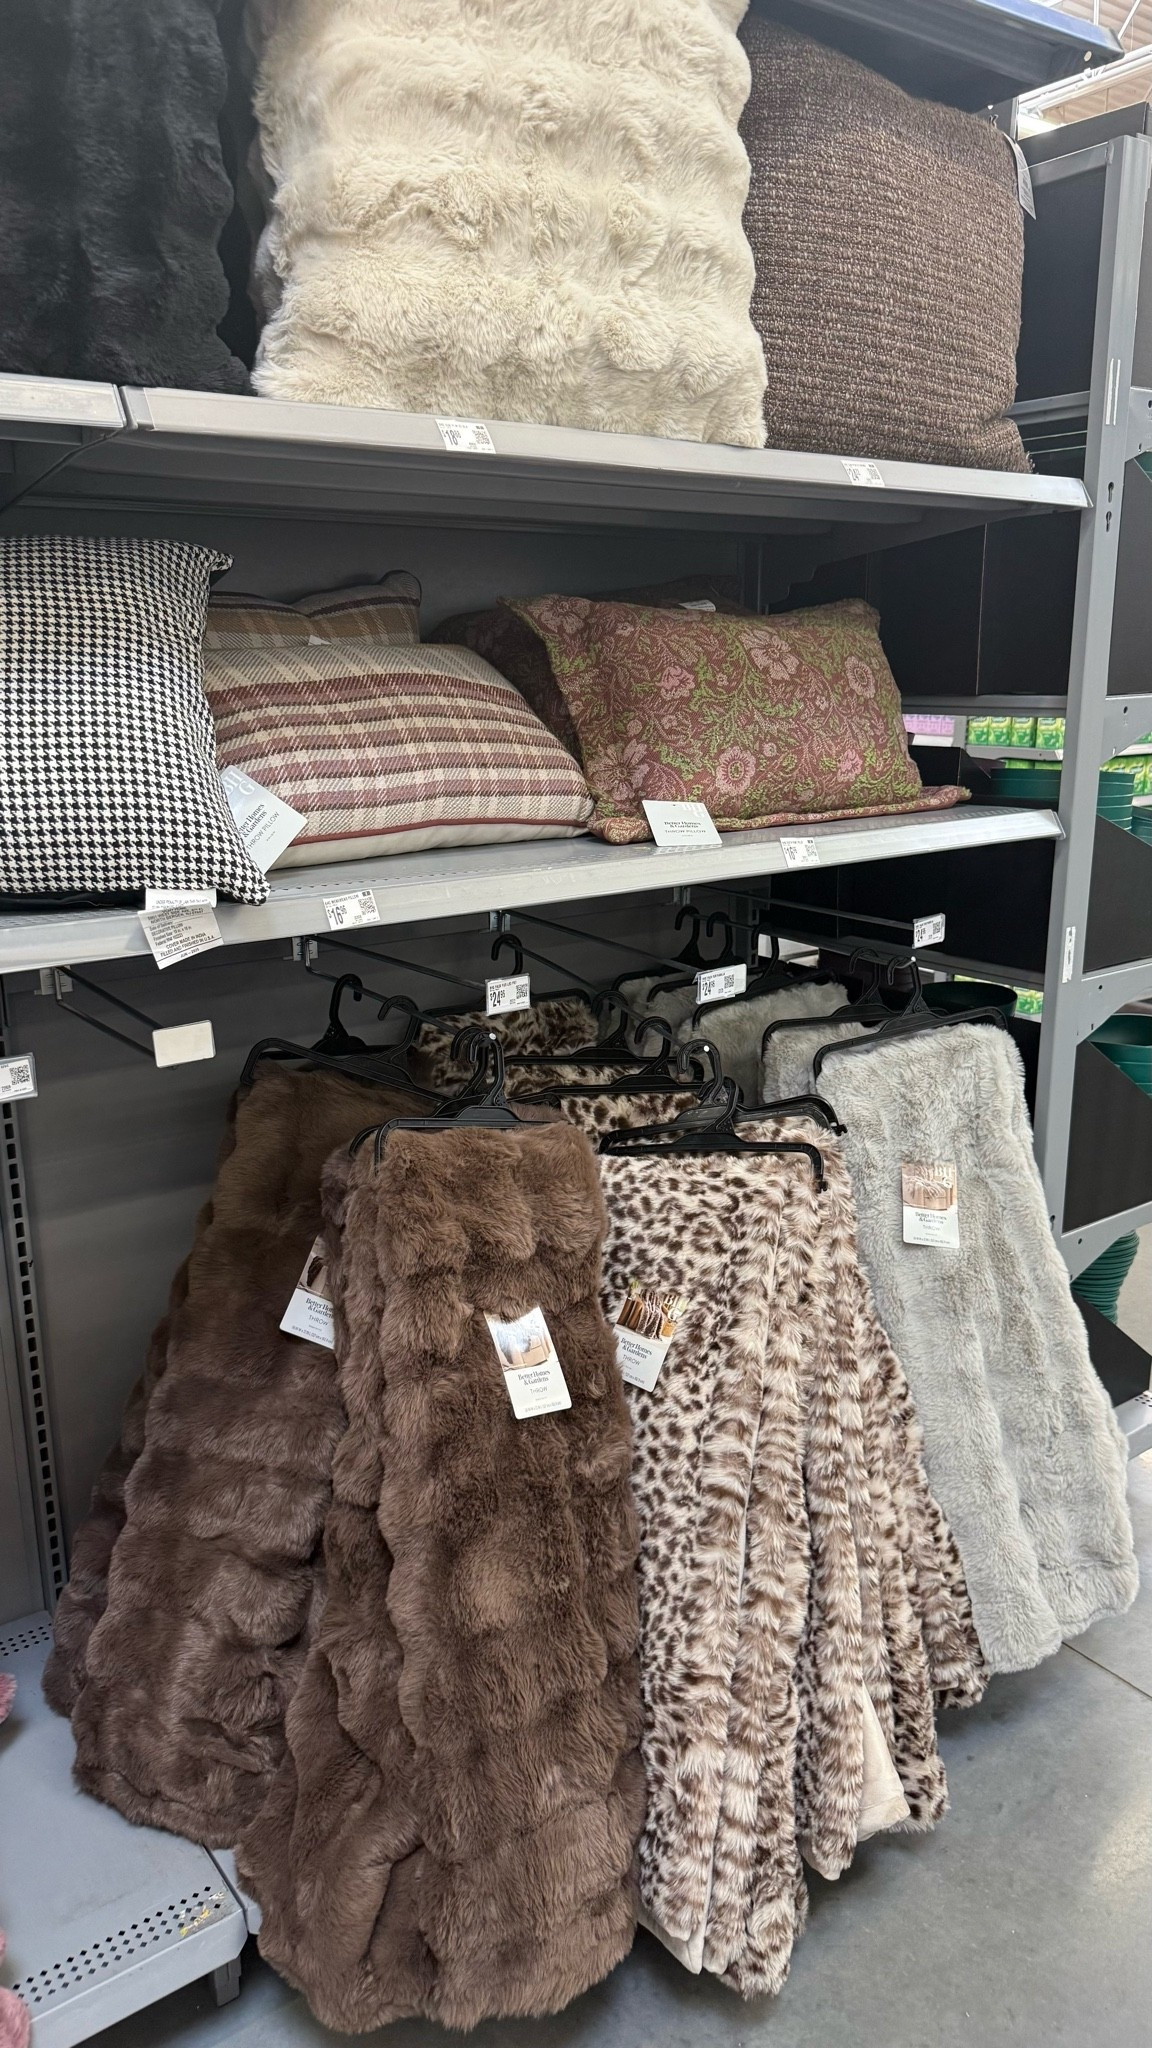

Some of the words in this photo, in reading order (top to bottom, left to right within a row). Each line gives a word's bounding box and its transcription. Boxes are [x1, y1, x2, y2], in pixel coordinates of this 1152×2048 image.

[248, 804, 265, 823] Homes
[247, 811, 268, 834] Gardens
[246, 830, 264, 850] THROW
[262, 811, 280, 831] PILLOW
[305, 1297, 323, 1309] Better
[312, 1306, 334, 1319] Garden
[308, 1314, 329, 1326] THROW
[620, 1337, 635, 1348] Better
[634, 1342, 653, 1356] Homes
[626, 1346, 647, 1360] Gardens
[622, 1354, 641, 1366] THROW
[517, 1373, 533, 1381] Better
[533, 1369, 551, 1378] Homes
[528, 1376, 550, 1385] Gardens
[529, 1386, 548, 1394] THROW
